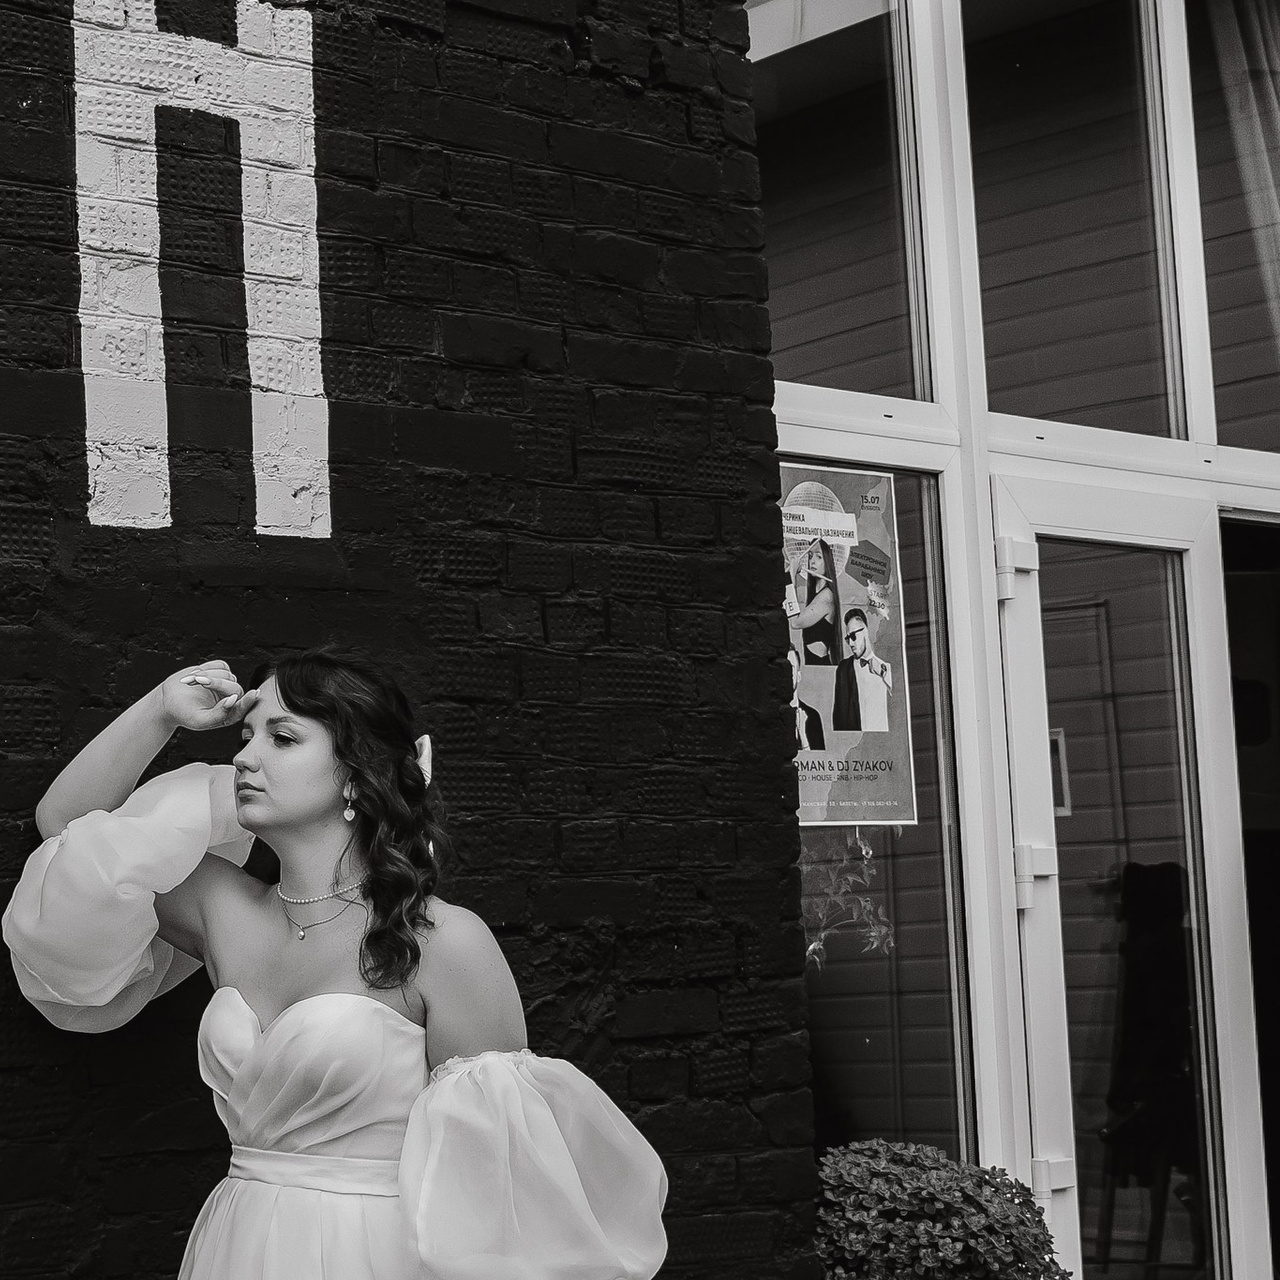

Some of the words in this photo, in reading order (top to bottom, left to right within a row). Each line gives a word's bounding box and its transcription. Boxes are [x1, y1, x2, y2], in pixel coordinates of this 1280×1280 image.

[860, 495, 880, 504] 15.07
[827, 760, 835, 771] &
[836, 760, 849, 771] DJ
[852, 760, 894, 772] ZYAKOV
[854, 774, 879, 782] HIP-HOP
